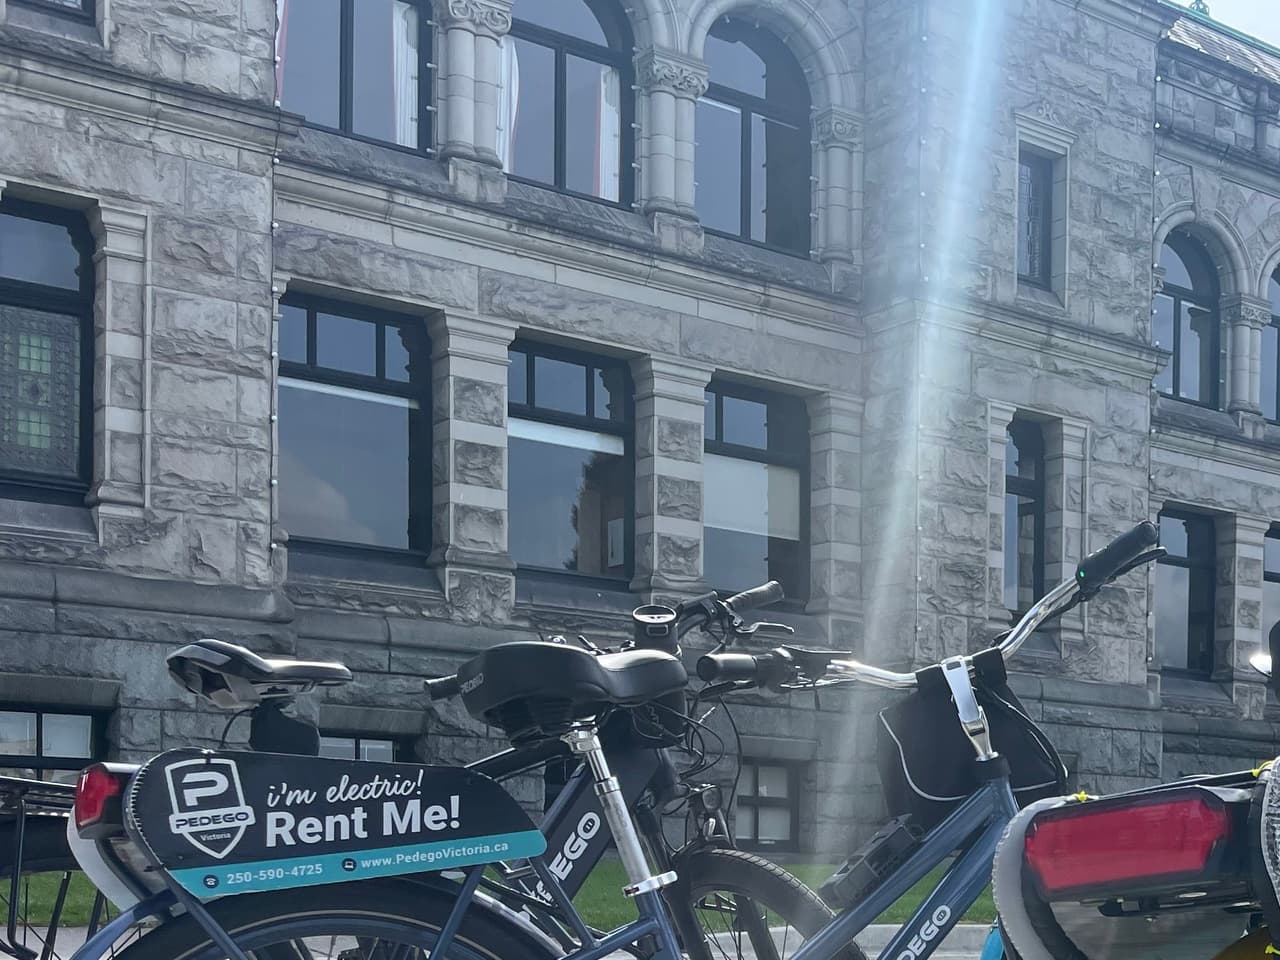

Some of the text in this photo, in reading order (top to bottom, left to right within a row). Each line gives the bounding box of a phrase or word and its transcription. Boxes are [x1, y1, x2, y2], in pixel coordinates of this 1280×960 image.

[181, 771, 229, 807] P
[266, 769, 424, 807] i'm electric!
[175, 811, 249, 829] PEDEGO
[266, 795, 460, 848] Rent Me!
[200, 832, 232, 841] Victoria
[361, 842, 509, 869] www.PedegoVictoria.ca
[226, 864, 323, 884] 250-590-4725
